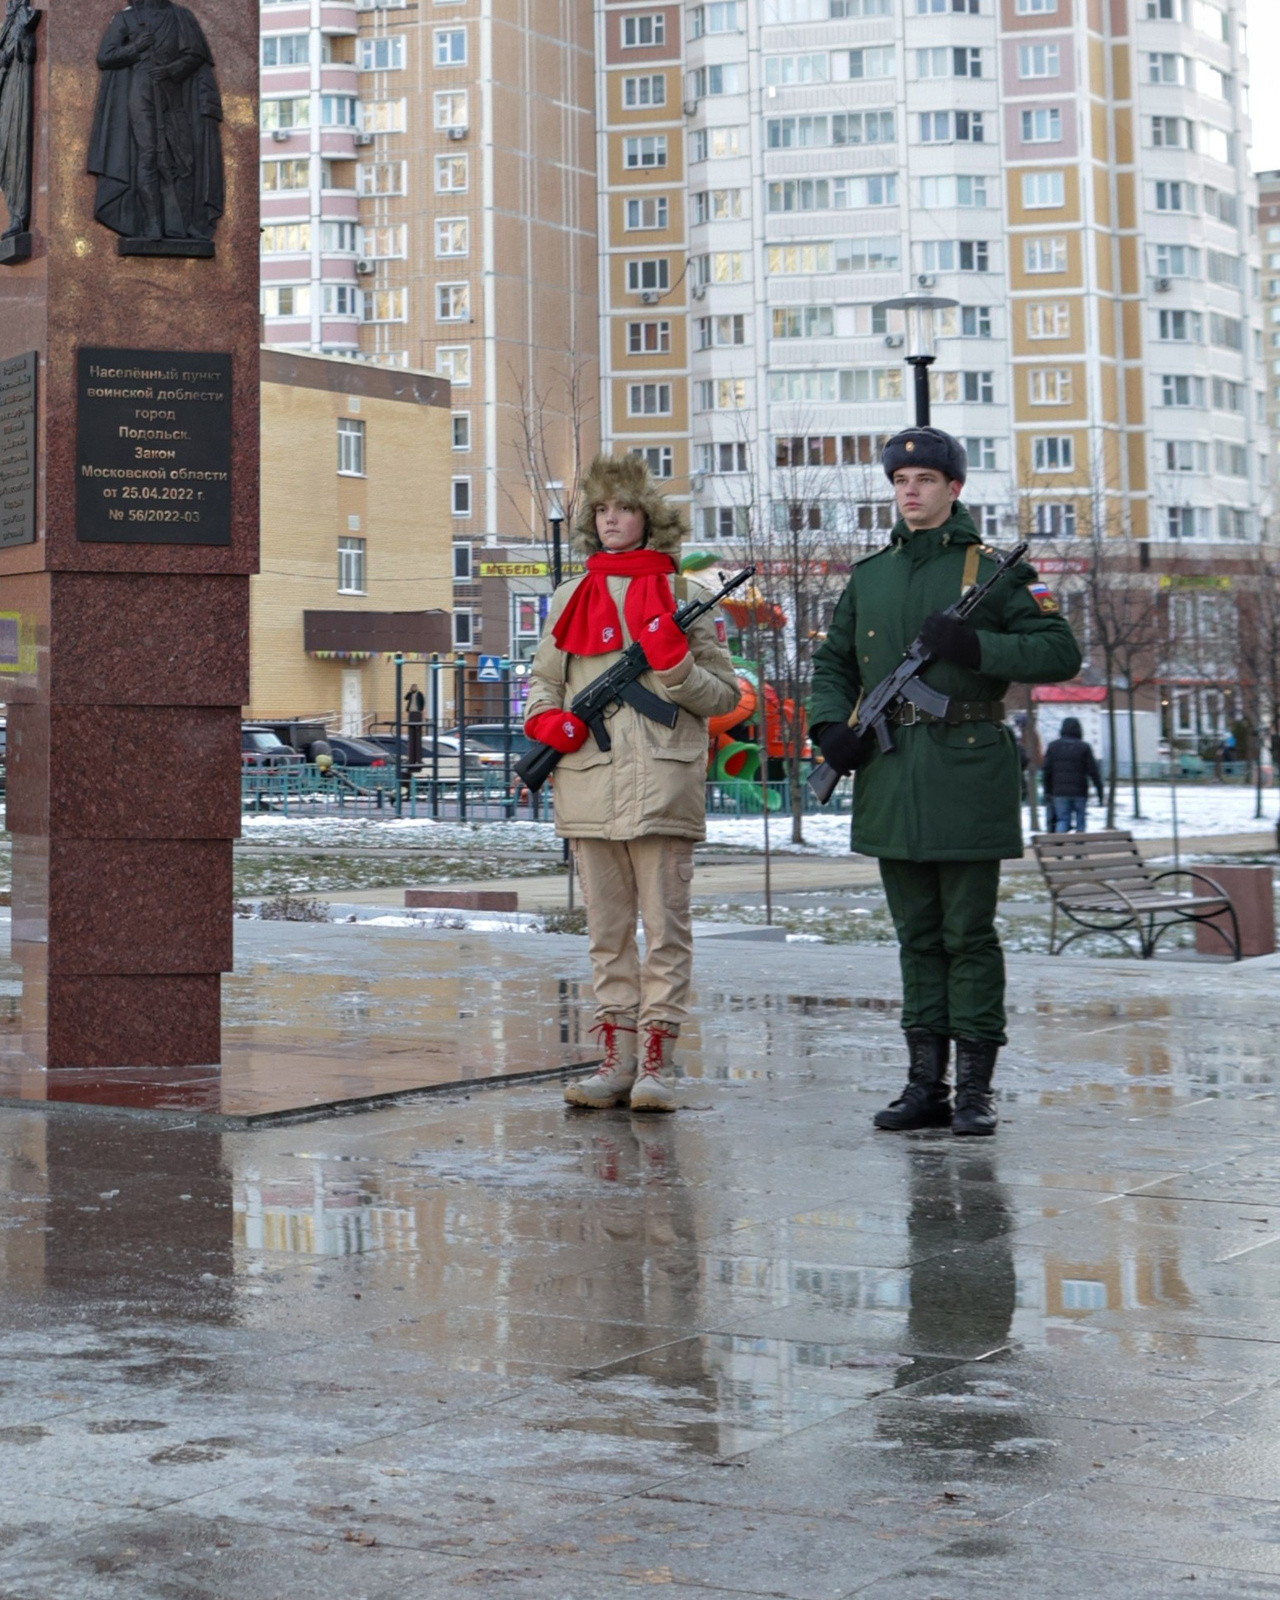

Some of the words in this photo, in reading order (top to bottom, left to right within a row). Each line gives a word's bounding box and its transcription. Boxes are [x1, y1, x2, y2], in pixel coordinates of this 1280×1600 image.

[89, 365, 178, 380] Населённый
[182, 371, 221, 383] пункт
[87, 387, 154, 399] воинской
[157, 388, 223, 401] доблести
[135, 409, 176, 421] город
[119, 426, 191, 440] Подольск.
[135, 446, 176, 459] Закон
[81, 465, 166, 480] Московской
[170, 468, 227, 481] области
[103, 488, 118, 498] от
[122, 486, 194, 500] 25.04.2022
[197, 491, 205, 500] г.
[109, 509, 124, 521] №
[486, 564, 540, 575] МЕБЕЛЬ
